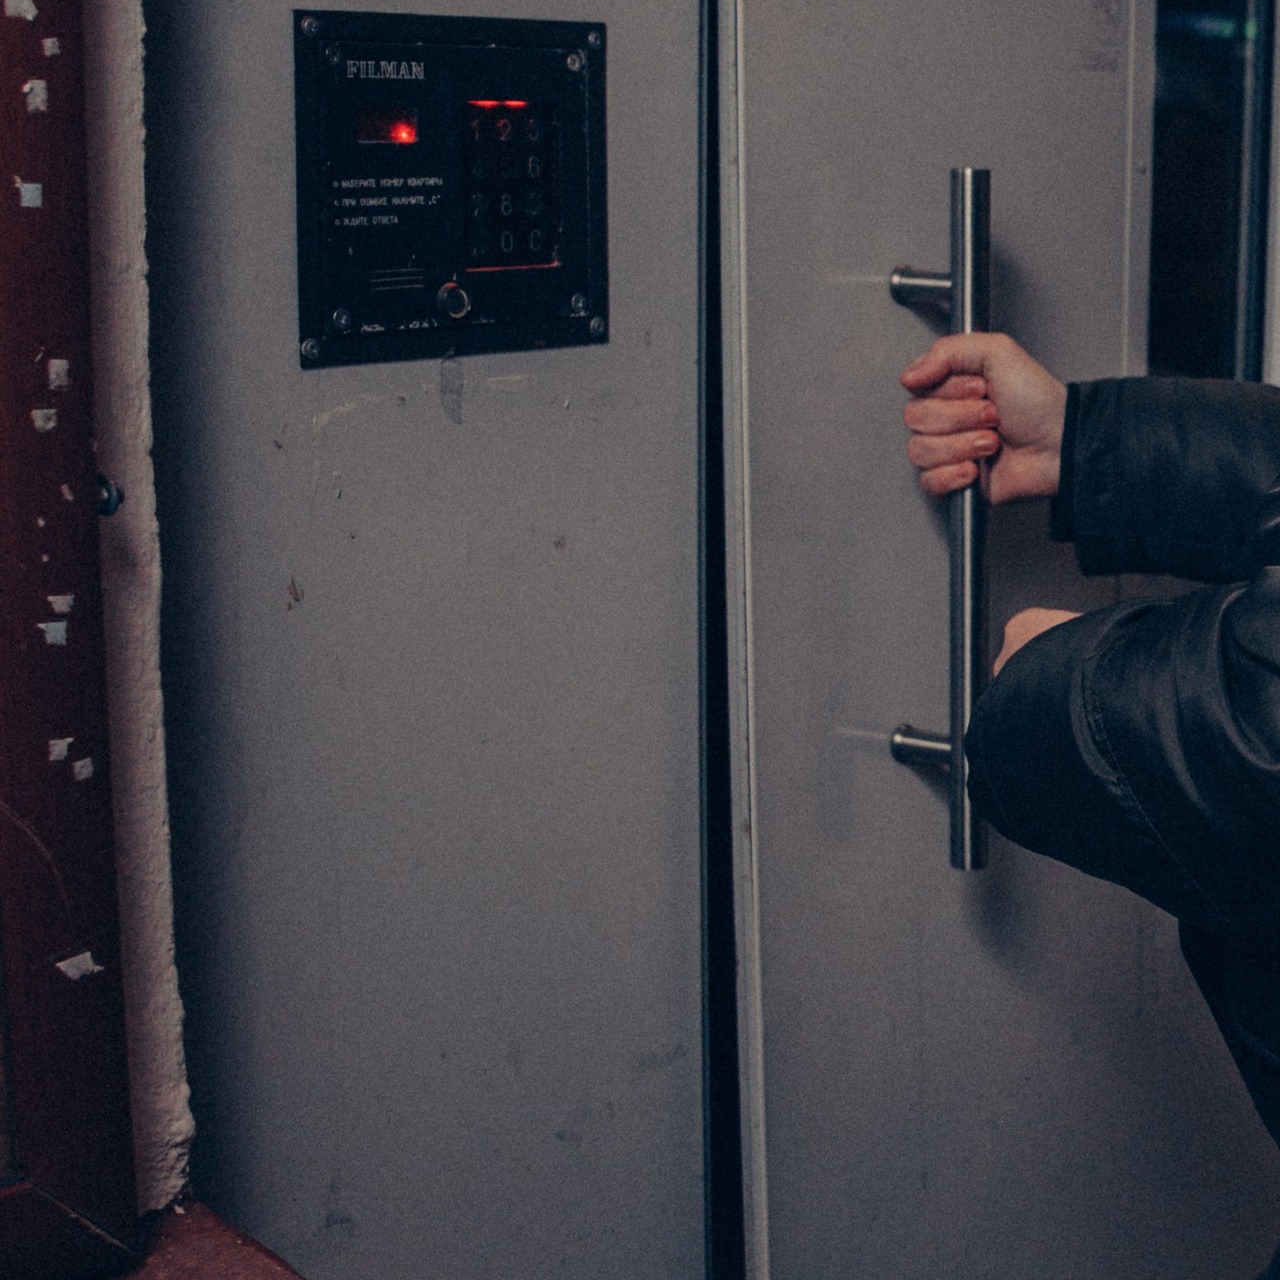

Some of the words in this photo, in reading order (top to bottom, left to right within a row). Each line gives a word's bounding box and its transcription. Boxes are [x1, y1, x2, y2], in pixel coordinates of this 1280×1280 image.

[346, 60, 426, 80] FILMAN
[496, 117, 512, 142] 2
[527, 155, 541, 178] 6
[500, 193, 513, 217] 8
[500, 231, 514, 253] 0
